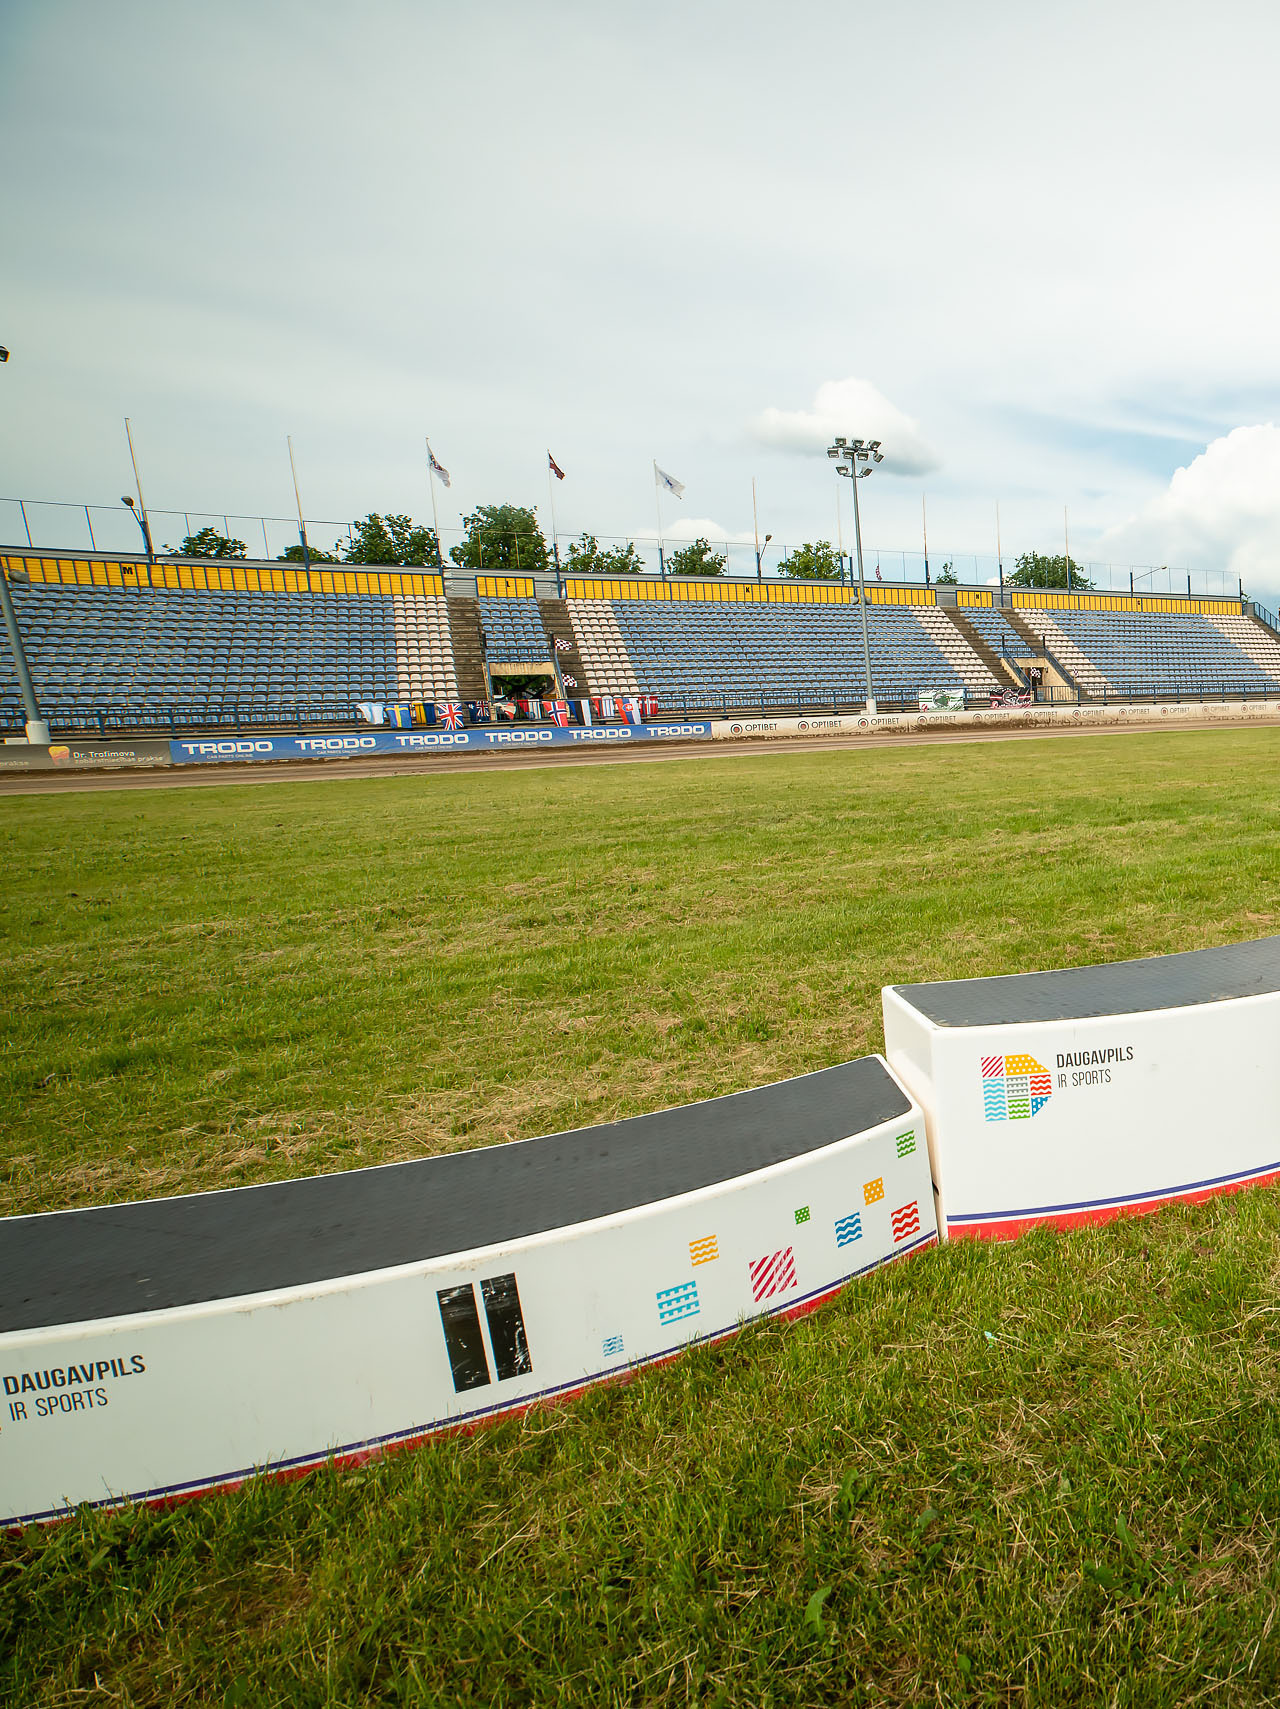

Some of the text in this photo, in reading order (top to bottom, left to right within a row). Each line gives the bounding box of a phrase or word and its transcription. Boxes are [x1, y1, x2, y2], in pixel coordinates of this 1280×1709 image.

[122, 566, 133, 575] M
[745, 723, 778, 732] OPTIBET
[811, 720, 842, 729] OPTIBET
[870, 717, 900, 726] OPTIBET
[485, 730, 553, 743] TRODO
[568, 728, 632, 740] TRODO
[646, 725, 705, 737] TRODO
[294, 737, 376, 751] TRODO
[395, 733, 469, 746] TRODO
[73, 750, 136, 759] Dr. Trofimova
[181, 741, 273, 755] TRODO
[1056, 1046, 1134, 1068] DAUGAVPILS
[1057, 1068, 1112, 1089] IR SPORTS
[2, 1354, 147, 1396] DAUGAVPILS
[8, 1387, 109, 1421] IR SPORTS
